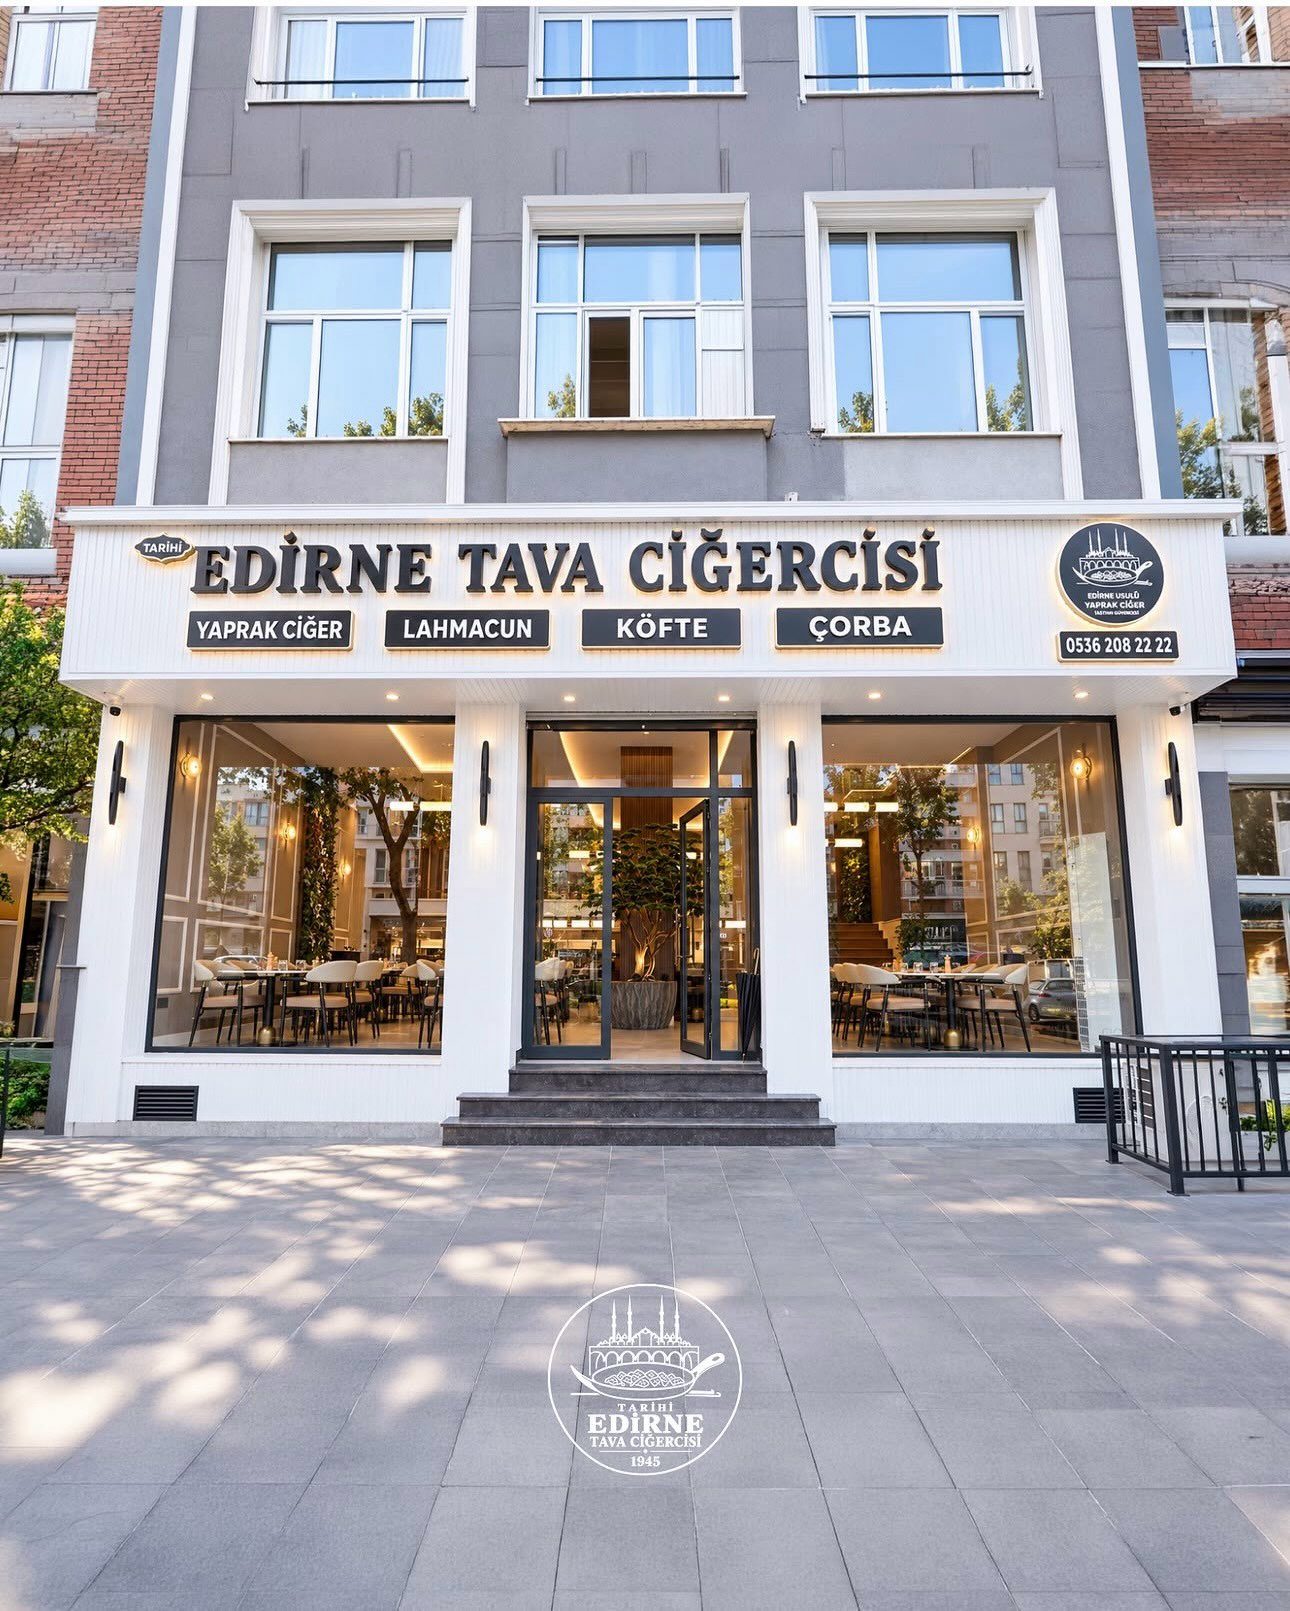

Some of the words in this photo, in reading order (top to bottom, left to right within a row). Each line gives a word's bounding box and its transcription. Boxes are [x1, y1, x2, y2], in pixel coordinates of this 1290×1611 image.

[143, 541, 183, 553] TARİHİ
[190, 530, 432, 595] EDİRNE
[458, 543, 604, 594] TAVA
[629, 526, 943, 593] CİĞERCİSİ
[1085, 601, 1118, 609] YAPRAK
[1119, 600, 1145, 609] CİĞER
[1087, 591, 1114, 600] EDİRNE
[196, 619, 279, 641] YAPRAK
[282, 614, 344, 640] CİĞER
[403, 618, 533, 640] LAHMACUN
[616, 612, 709, 640] KÖFTE
[808, 614, 913, 642] ÇORBA
[1065, 637, 1101, 653] 0536
[1104, 637, 1132, 653] 208
[1135, 637, 1152, 653] 22
[1155, 637, 1173, 653] 22
